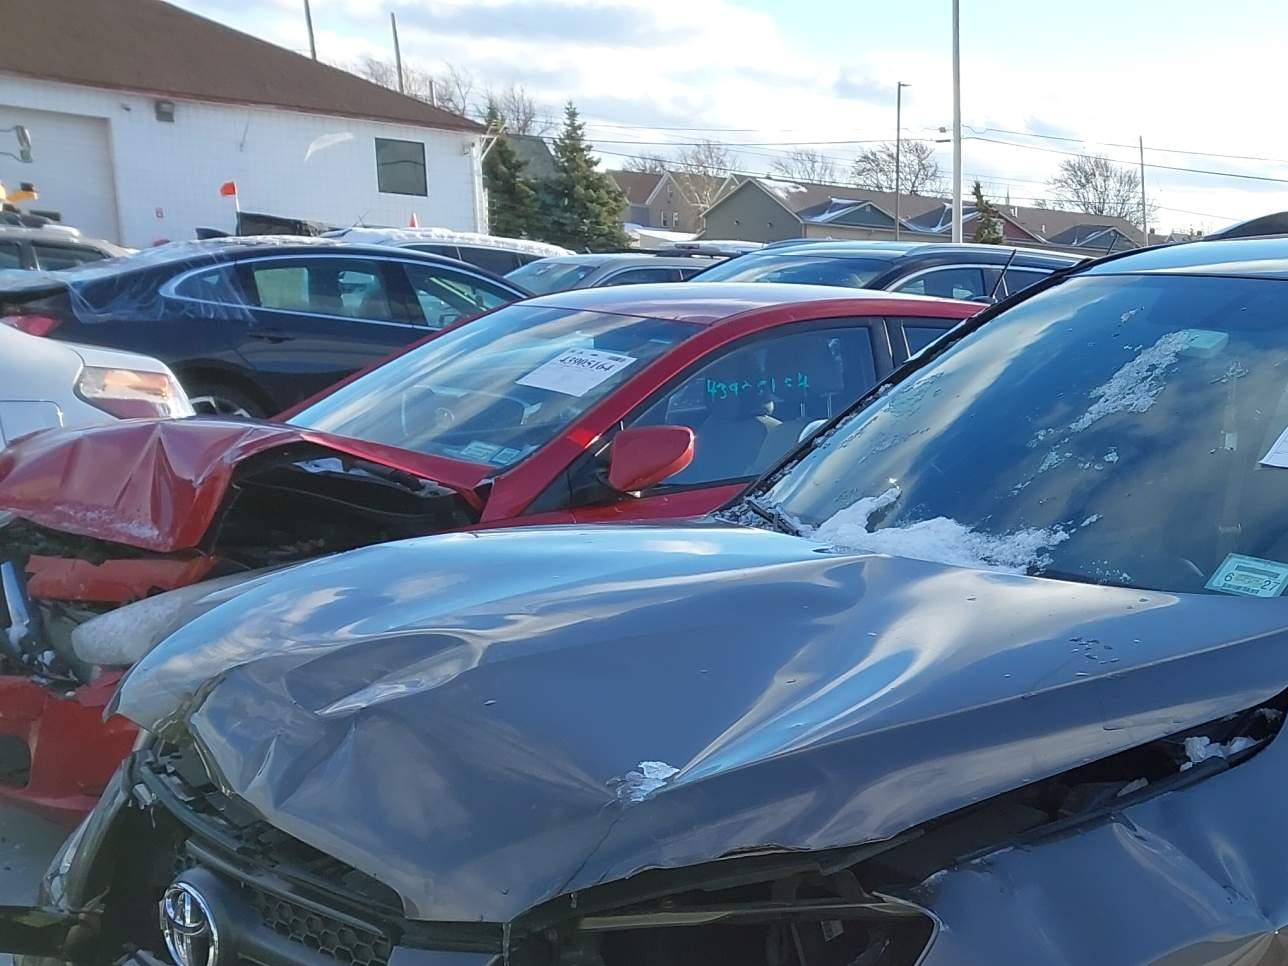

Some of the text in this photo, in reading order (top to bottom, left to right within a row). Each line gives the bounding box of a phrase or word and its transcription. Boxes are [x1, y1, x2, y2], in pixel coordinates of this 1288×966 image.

[560, 356, 615, 372] 43905164
[1224, 572, 1235, 582] 6
[1260, 579, 1280, 592] 27
